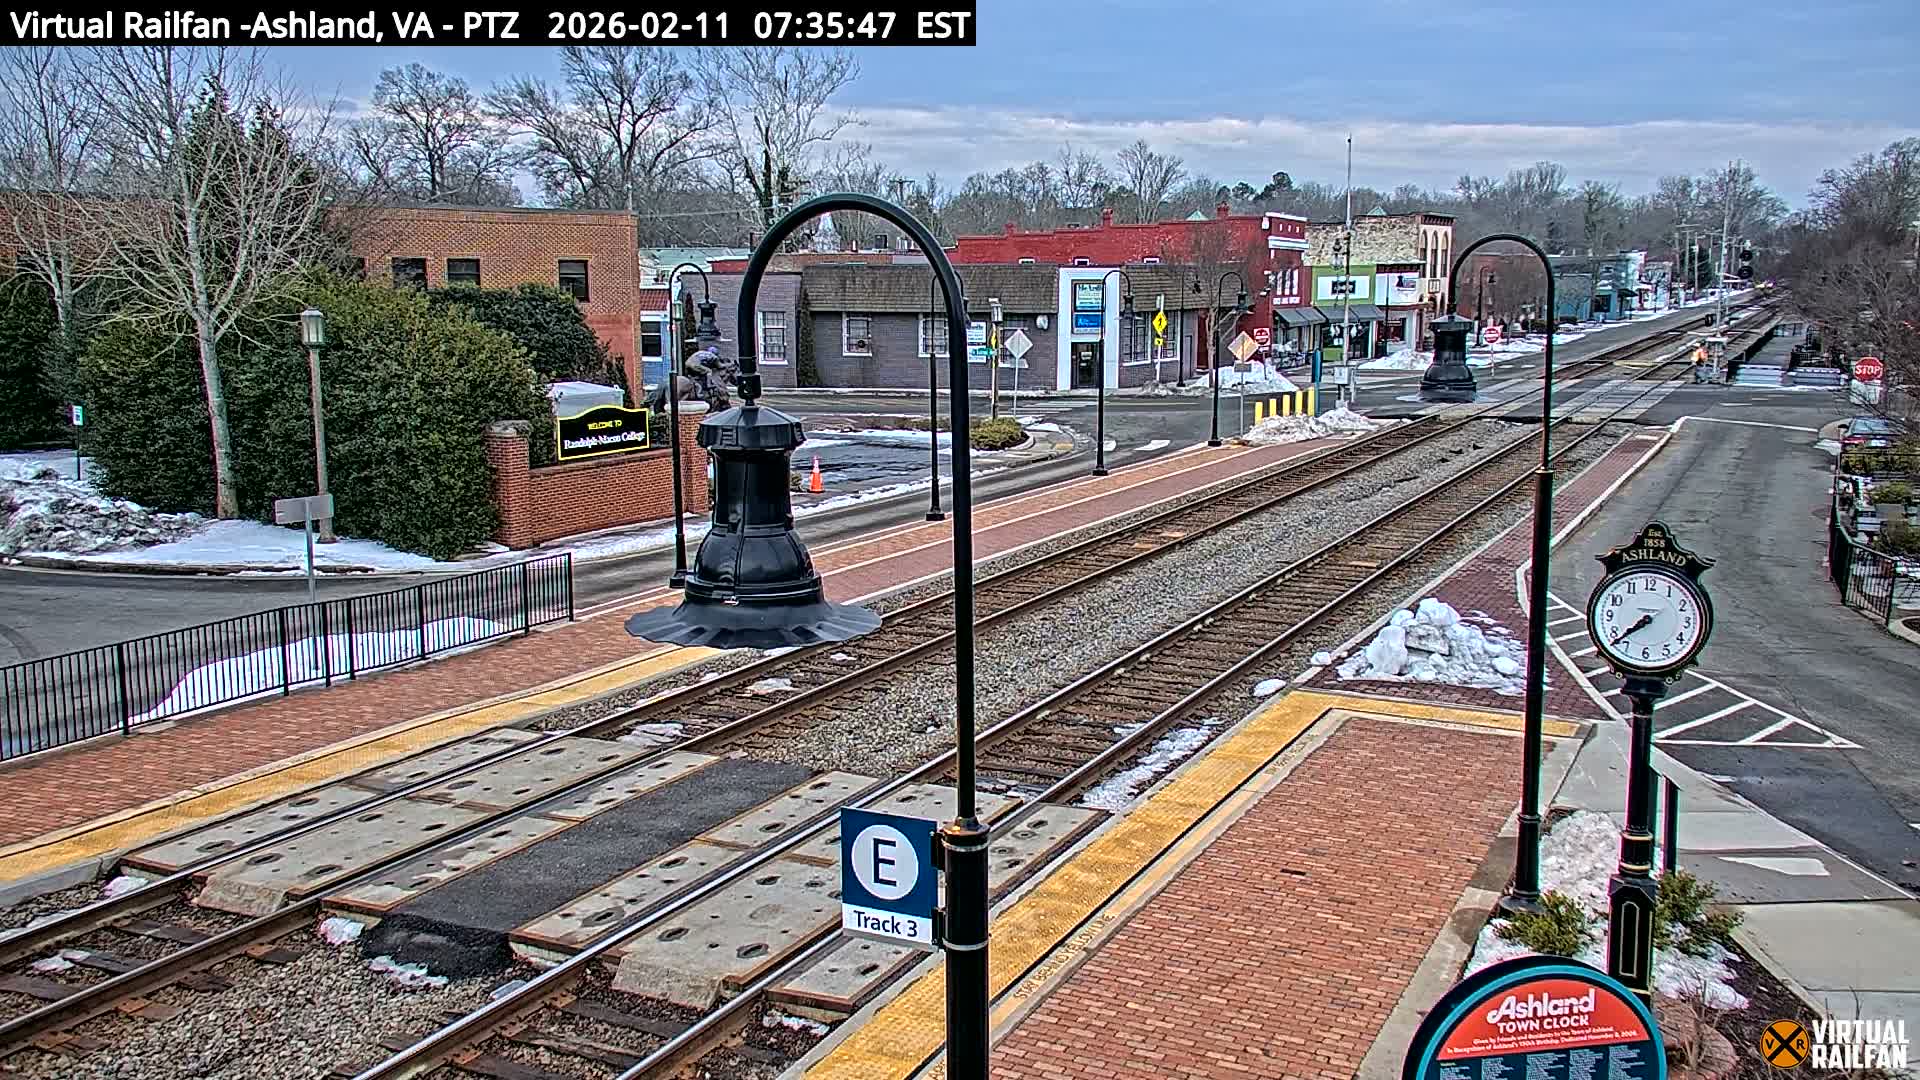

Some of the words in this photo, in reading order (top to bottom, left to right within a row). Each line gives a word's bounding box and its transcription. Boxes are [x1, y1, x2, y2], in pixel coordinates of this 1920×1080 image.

[1856, 366, 1880, 375] STOP
[622, 432, 646, 441] College
[1644, 539, 1666, 548] 1858
[1622, 549, 1687, 567] ASHLAND
[1627, 582, 1636, 594] 11
[1644, 579, 1657, 591] 12
[1666, 586, 1672, 597] 1
[1610, 594, 1623, 607] 10
[1678, 599, 1687, 612] 2
[1606, 609, 1614, 622] 9
[1683, 617, 1691, 629] 3
[1610, 627, 1618, 639] 8
[1676, 632, 1685, 644] 4
[1622, 641, 1630, 651] 7
[1662, 644, 1670, 656] 5
[1642, 647, 1650, 659] 6
[873, 838, 897, 887] E
[854, 910, 901, 935] Track
[907, 920, 918, 937] 3
[1487, 988, 1596, 1024] Ashland
[1497, 1020, 1540, 1034] TOWN
[1543, 1014, 1589, 1030] CLOCK
